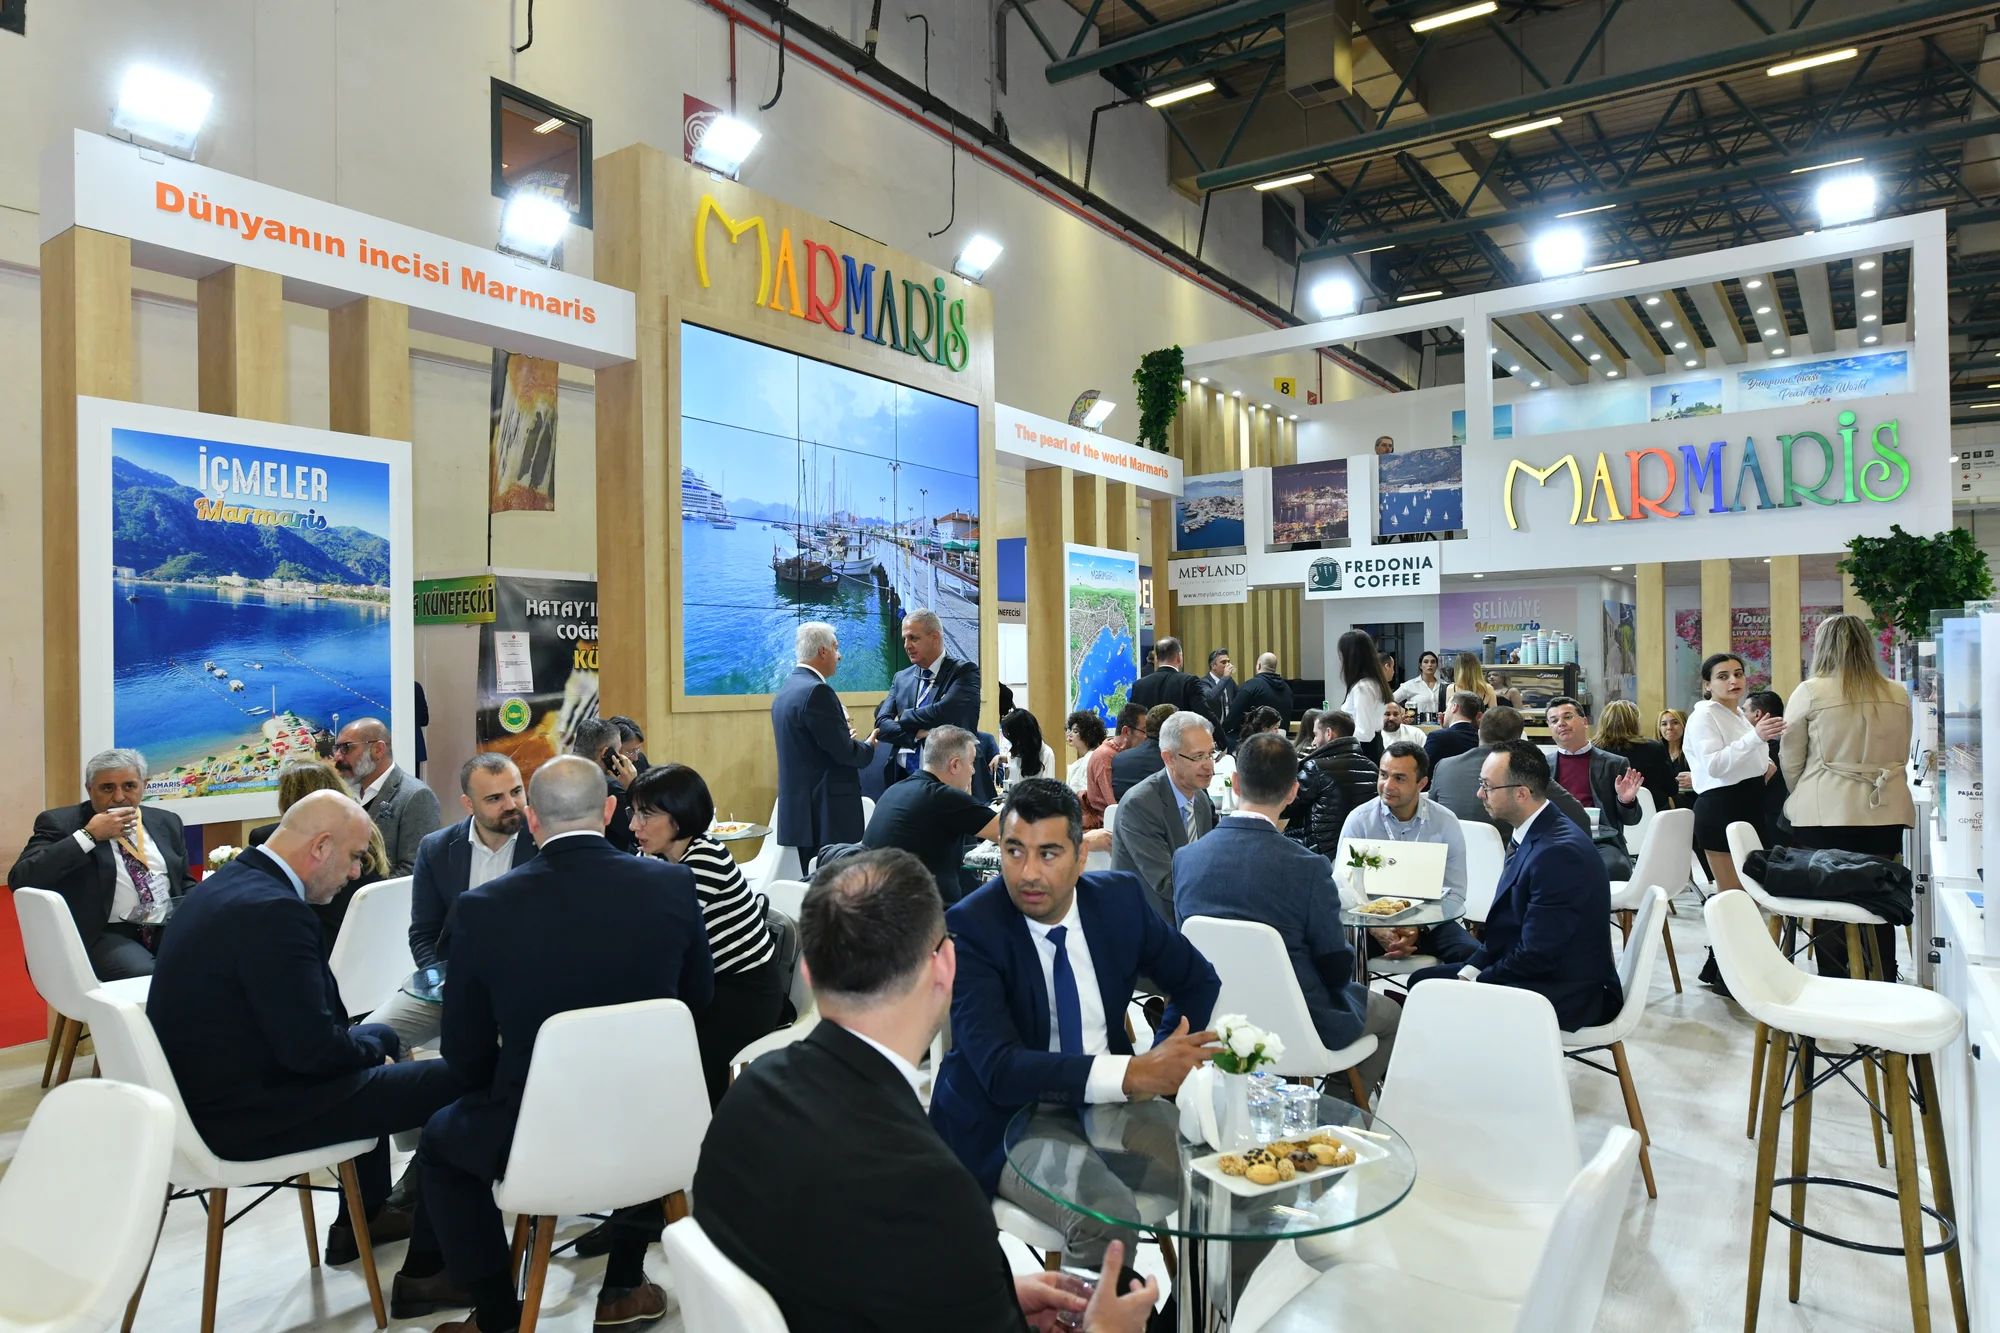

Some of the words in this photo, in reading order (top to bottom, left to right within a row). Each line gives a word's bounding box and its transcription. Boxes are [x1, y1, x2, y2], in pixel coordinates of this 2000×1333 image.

[156, 181, 345, 258] Dünyanın
[359, 238, 449, 285] incisi
[461, 266, 596, 324] Marmaris
[1281, 382, 1290, 395] 8
[1779, 386, 1808, 400] Pearl
[1809, 385, 1820, 396] of
[1819, 384, 1833, 394] the
[1836, 380, 1868, 393] World
[1015, 423, 1037, 442] The
[1040, 434, 1068, 452] pearl
[1070, 441, 1081, 454] of
[1083, 444, 1099, 460] the
[1102, 450, 1128, 468] world
[1130, 457, 1169, 479] Marmaris
[199, 446, 328, 502] İÇMELER
[194, 497, 327, 530] Marmaris
[1179, 563, 1246, 579] MEYLAND
[1345, 556, 1433, 573] FREDONIA
[1354, 573, 1420, 588] COFFEE
[423, 581, 494, 617] KÜNEFECİSİ
[1183, 590, 1241, 599] www.meyland.com.tr
[526, 599, 598, 618] HATAY'I
[557, 621, 598, 640] COĞR
[1474, 620, 1540, 632] Marmaris
[574, 646, 598, 669] KÜ
[147, 781, 180, 789] ARMARIS
